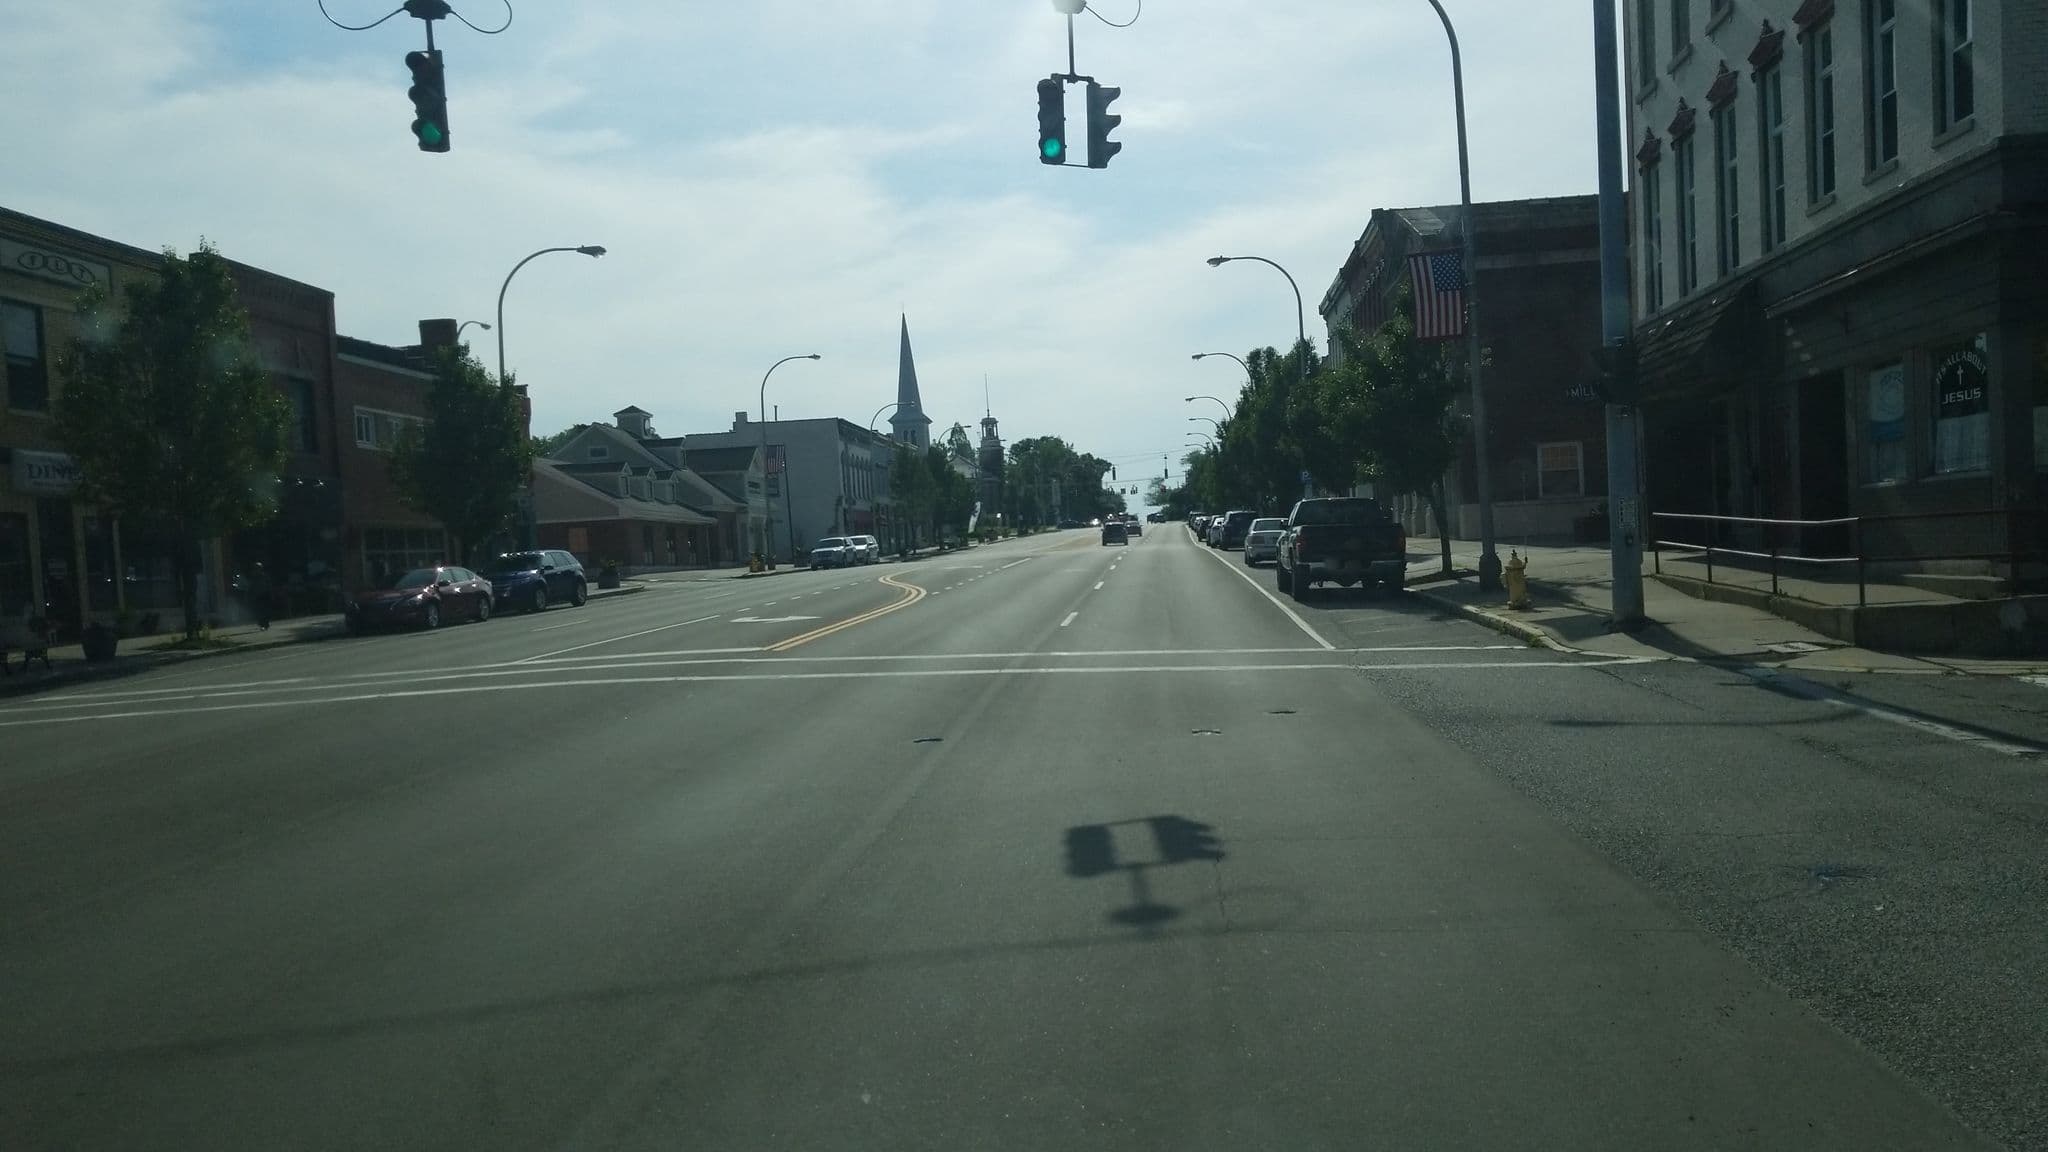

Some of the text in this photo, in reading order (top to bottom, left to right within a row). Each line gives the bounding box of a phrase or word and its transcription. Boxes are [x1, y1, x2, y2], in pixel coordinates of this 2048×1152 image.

[1946, 352, 1961, 367] ALL
[1961, 351, 1986, 375] ABOUT
[1942, 387, 1981, 405] JESUS
